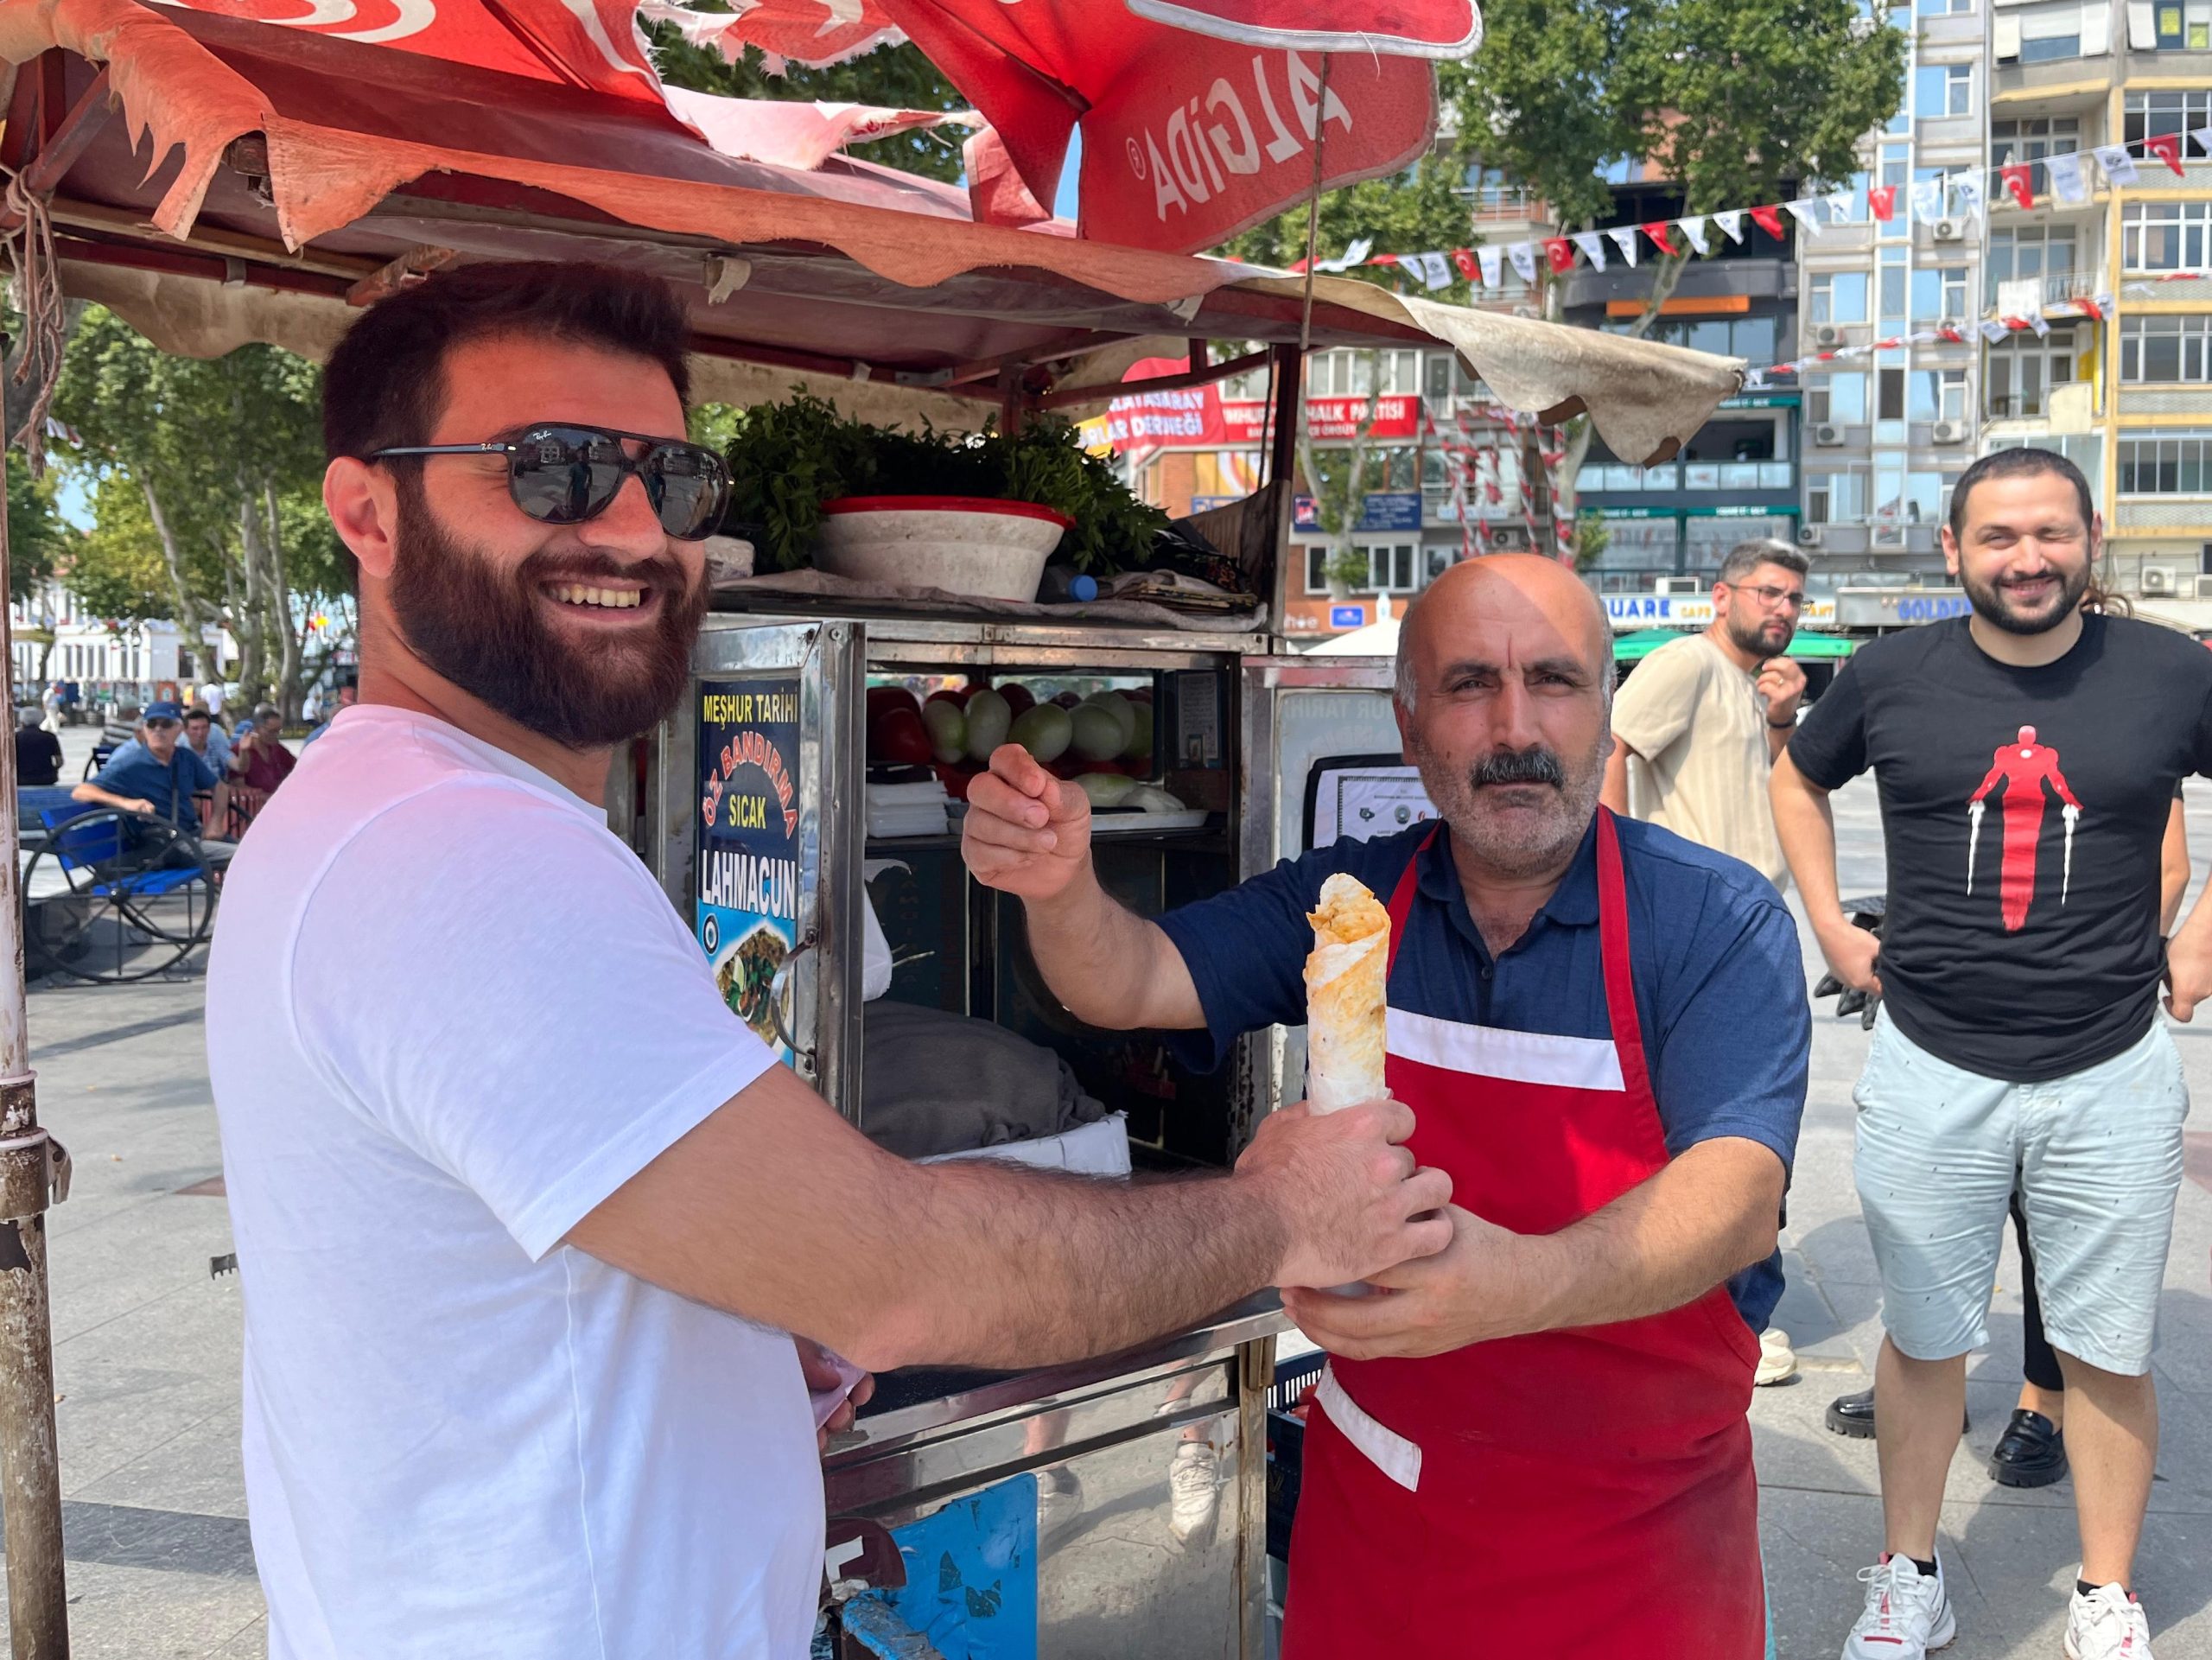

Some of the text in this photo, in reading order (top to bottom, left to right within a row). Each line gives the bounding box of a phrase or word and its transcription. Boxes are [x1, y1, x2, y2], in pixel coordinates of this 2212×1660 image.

[1605, 597, 1670, 619] UARE
[703, 686, 798, 731] MEŞHUR TARİHİ
[702, 730, 798, 840] ÖZ BANDIRMA
[728, 793, 767, 830] SICAK
[702, 849, 796, 921] LAHMACUN
